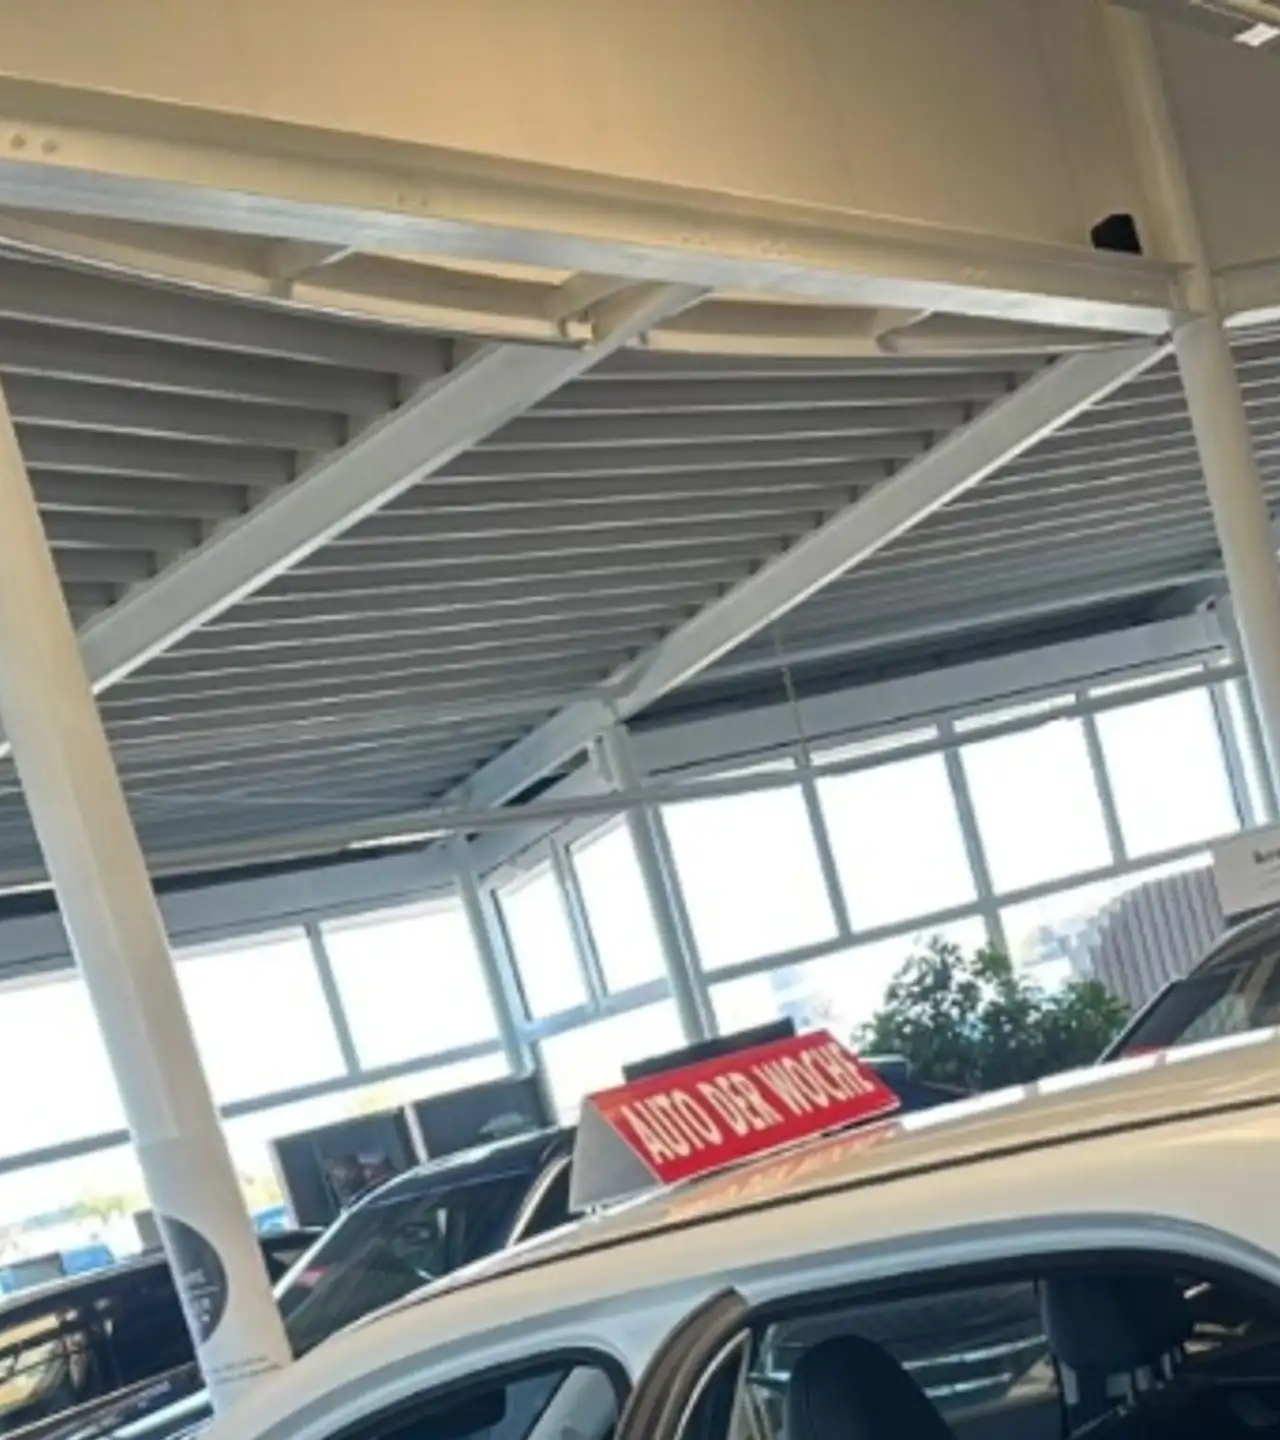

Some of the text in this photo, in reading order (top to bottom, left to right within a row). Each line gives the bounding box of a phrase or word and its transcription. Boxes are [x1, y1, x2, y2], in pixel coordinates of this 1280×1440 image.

[621, 1041, 877, 1166] AUTO DER WOCHE
